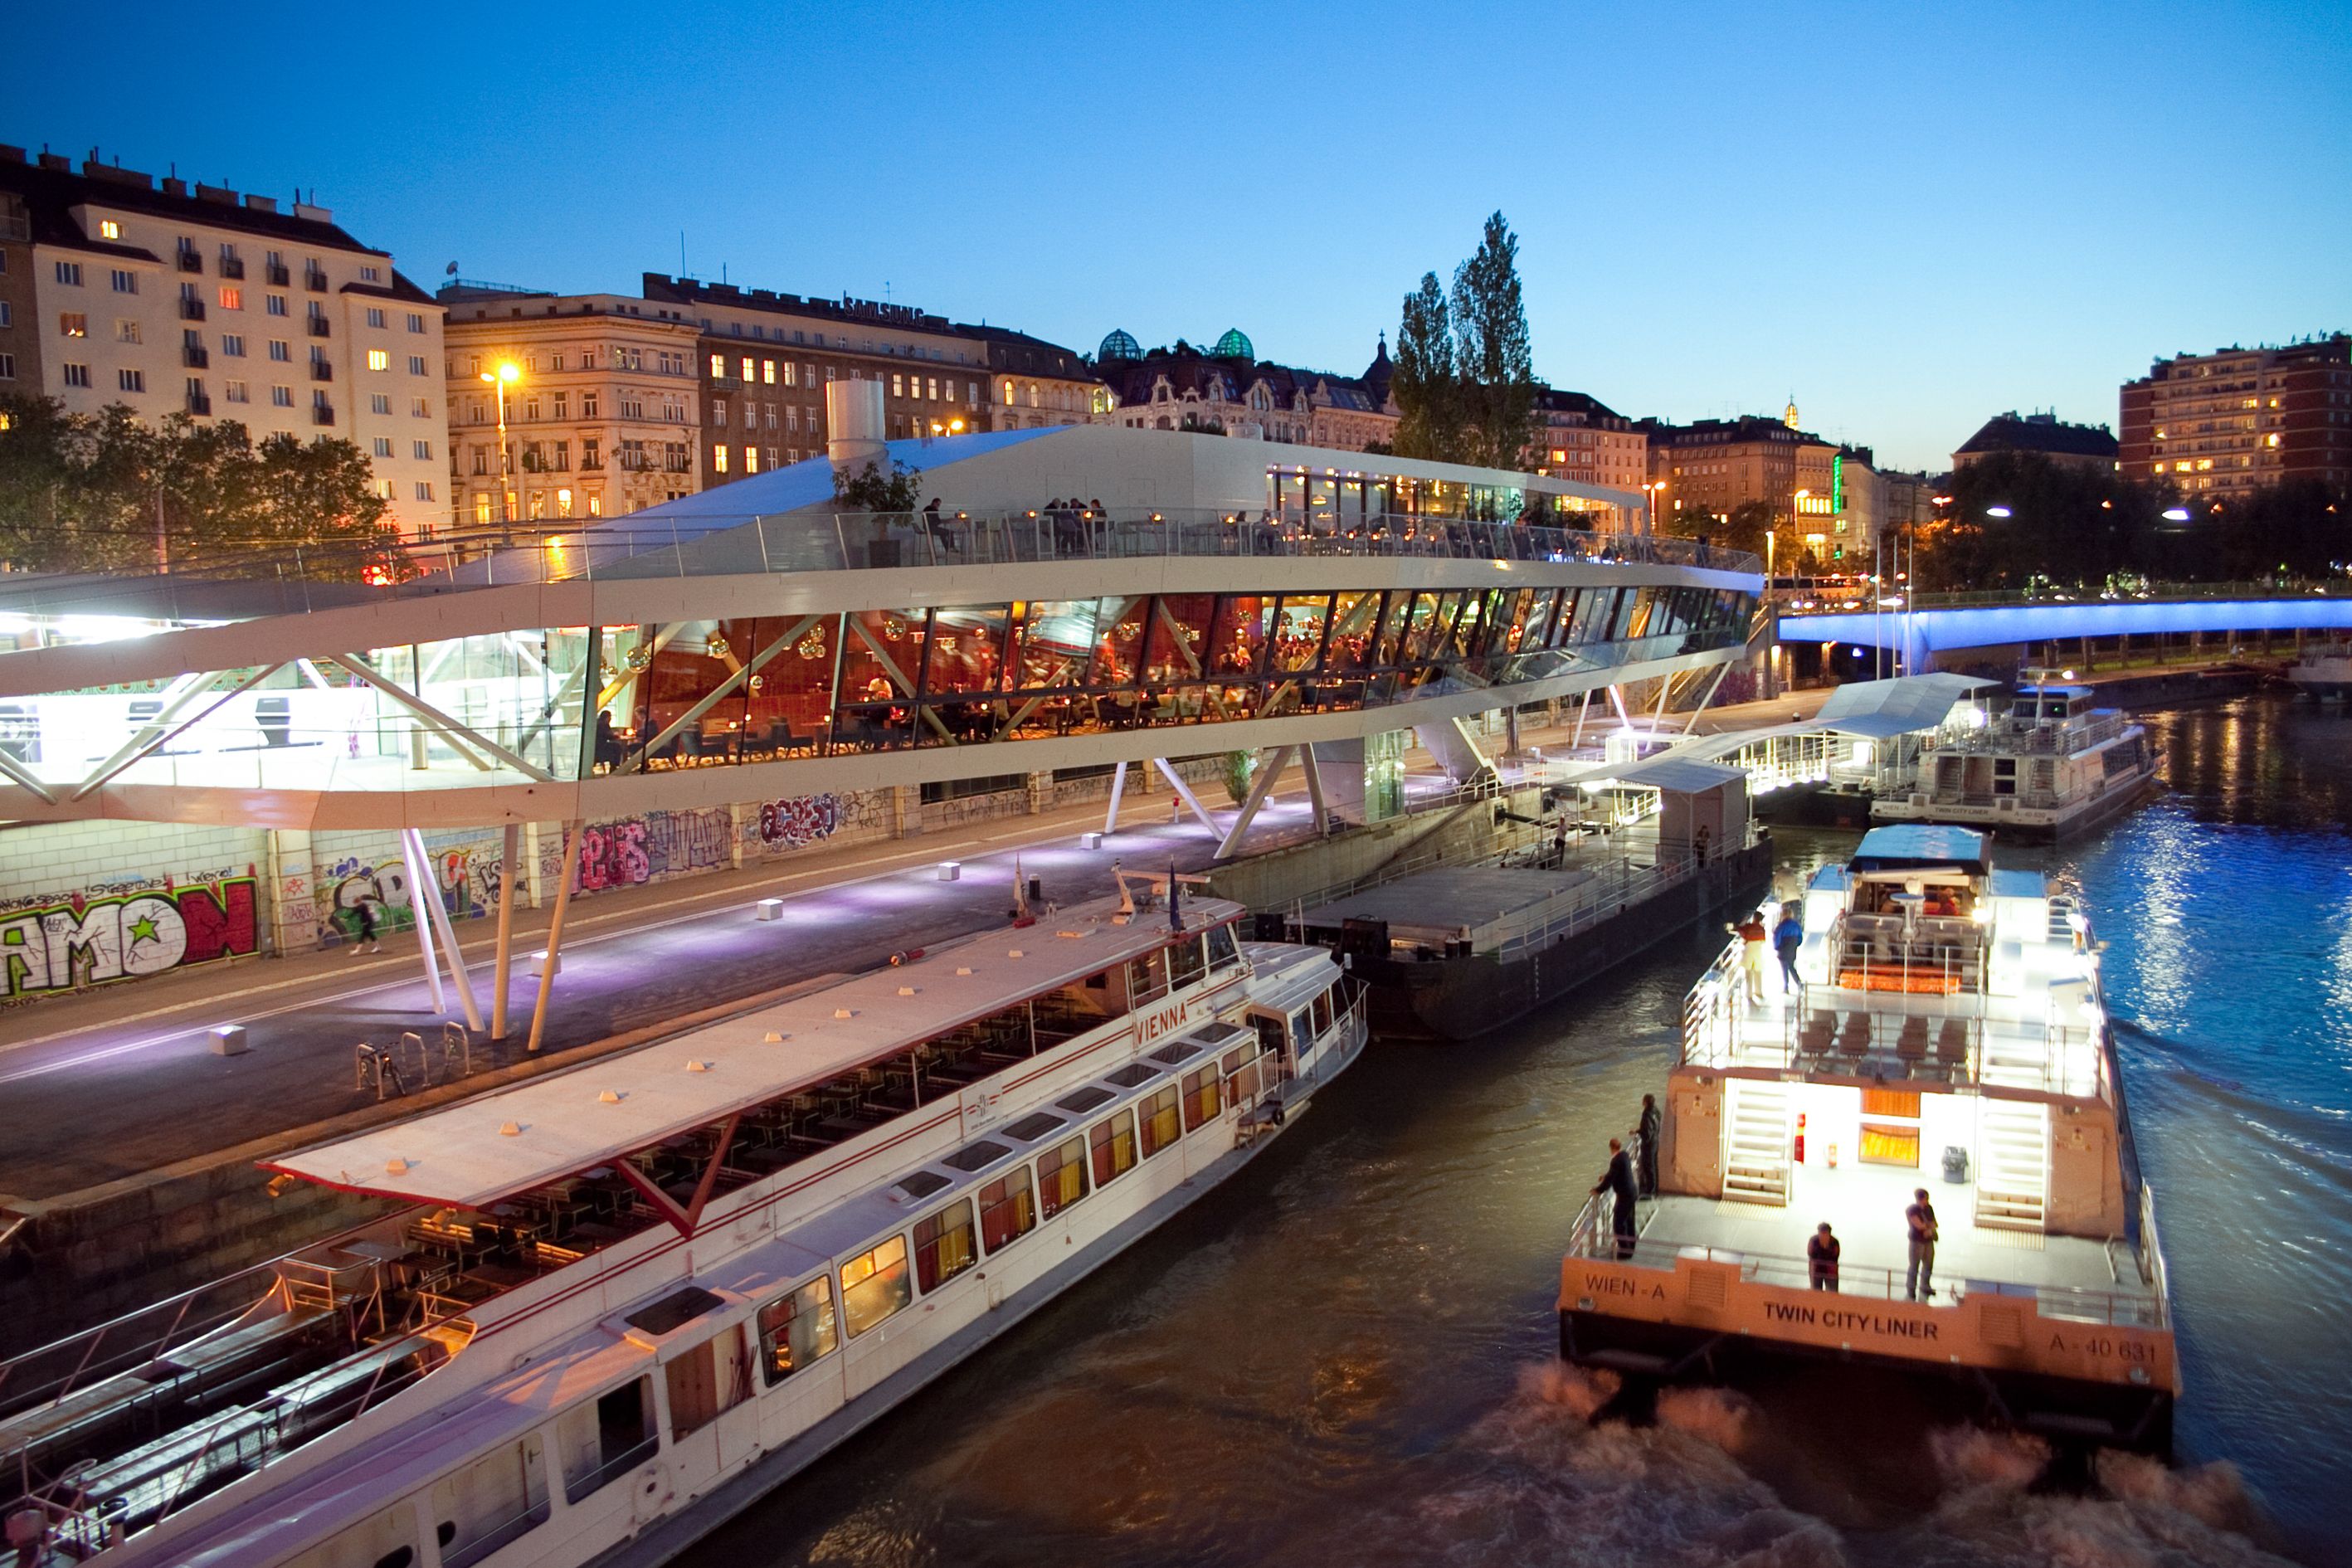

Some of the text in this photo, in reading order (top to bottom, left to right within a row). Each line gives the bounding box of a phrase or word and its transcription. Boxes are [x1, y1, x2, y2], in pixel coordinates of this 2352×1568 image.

[844, 297, 925, 326] SAMSUNG
[1137, 1001, 1187, 1045] VIENNA
[1586, 1273, 1636, 1296] WIEN
[1653, 1284, 1666, 1301] A
[1763, 1301, 1939, 1341] TWIN CITY LINER
[2049, 1334, 2066, 1353] A
[2085, 1337, 2112, 1358] 40
[2118, 1340, 2155, 1364] 631
